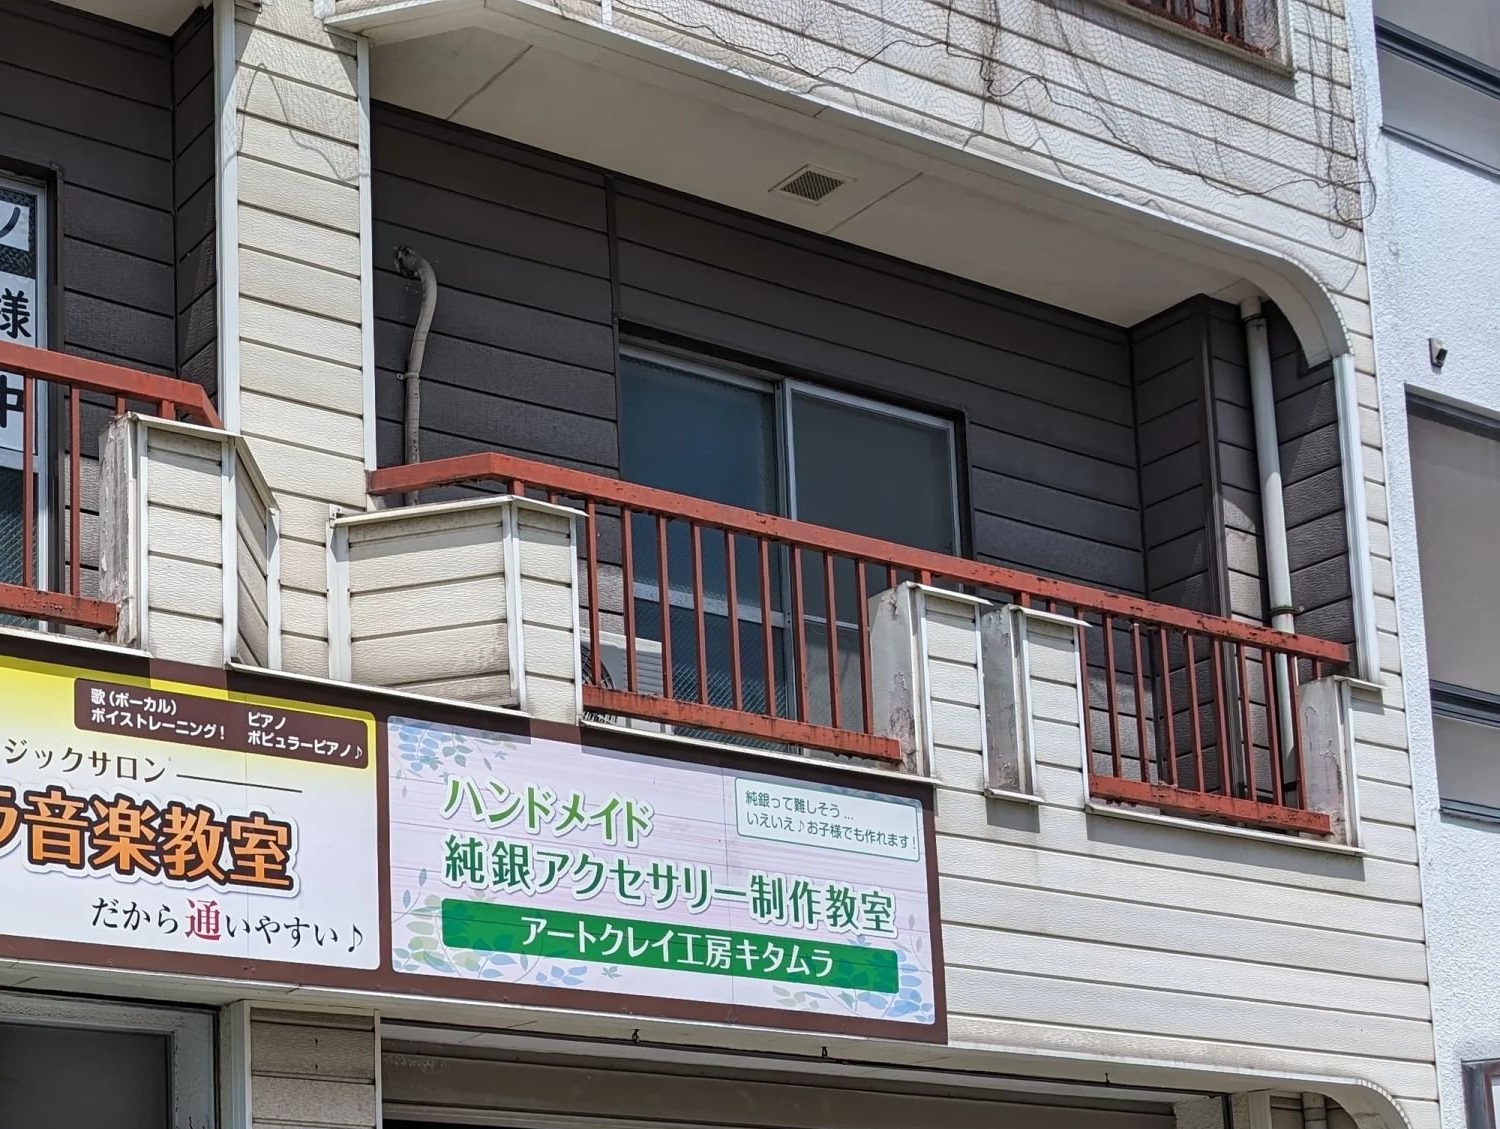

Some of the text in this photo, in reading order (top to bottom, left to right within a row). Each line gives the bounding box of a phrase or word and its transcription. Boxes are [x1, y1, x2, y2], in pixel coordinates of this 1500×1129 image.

[91, 708, 225, 740] ボイストレーニング！
[248, 712, 286, 731] ピアノ
[444, 778, 651, 844] ハンドメイド
[445, 838, 895, 935] 純銀アクセサリー制作教室
[521, 916, 834, 978] アートクレイ工房キタムラ
